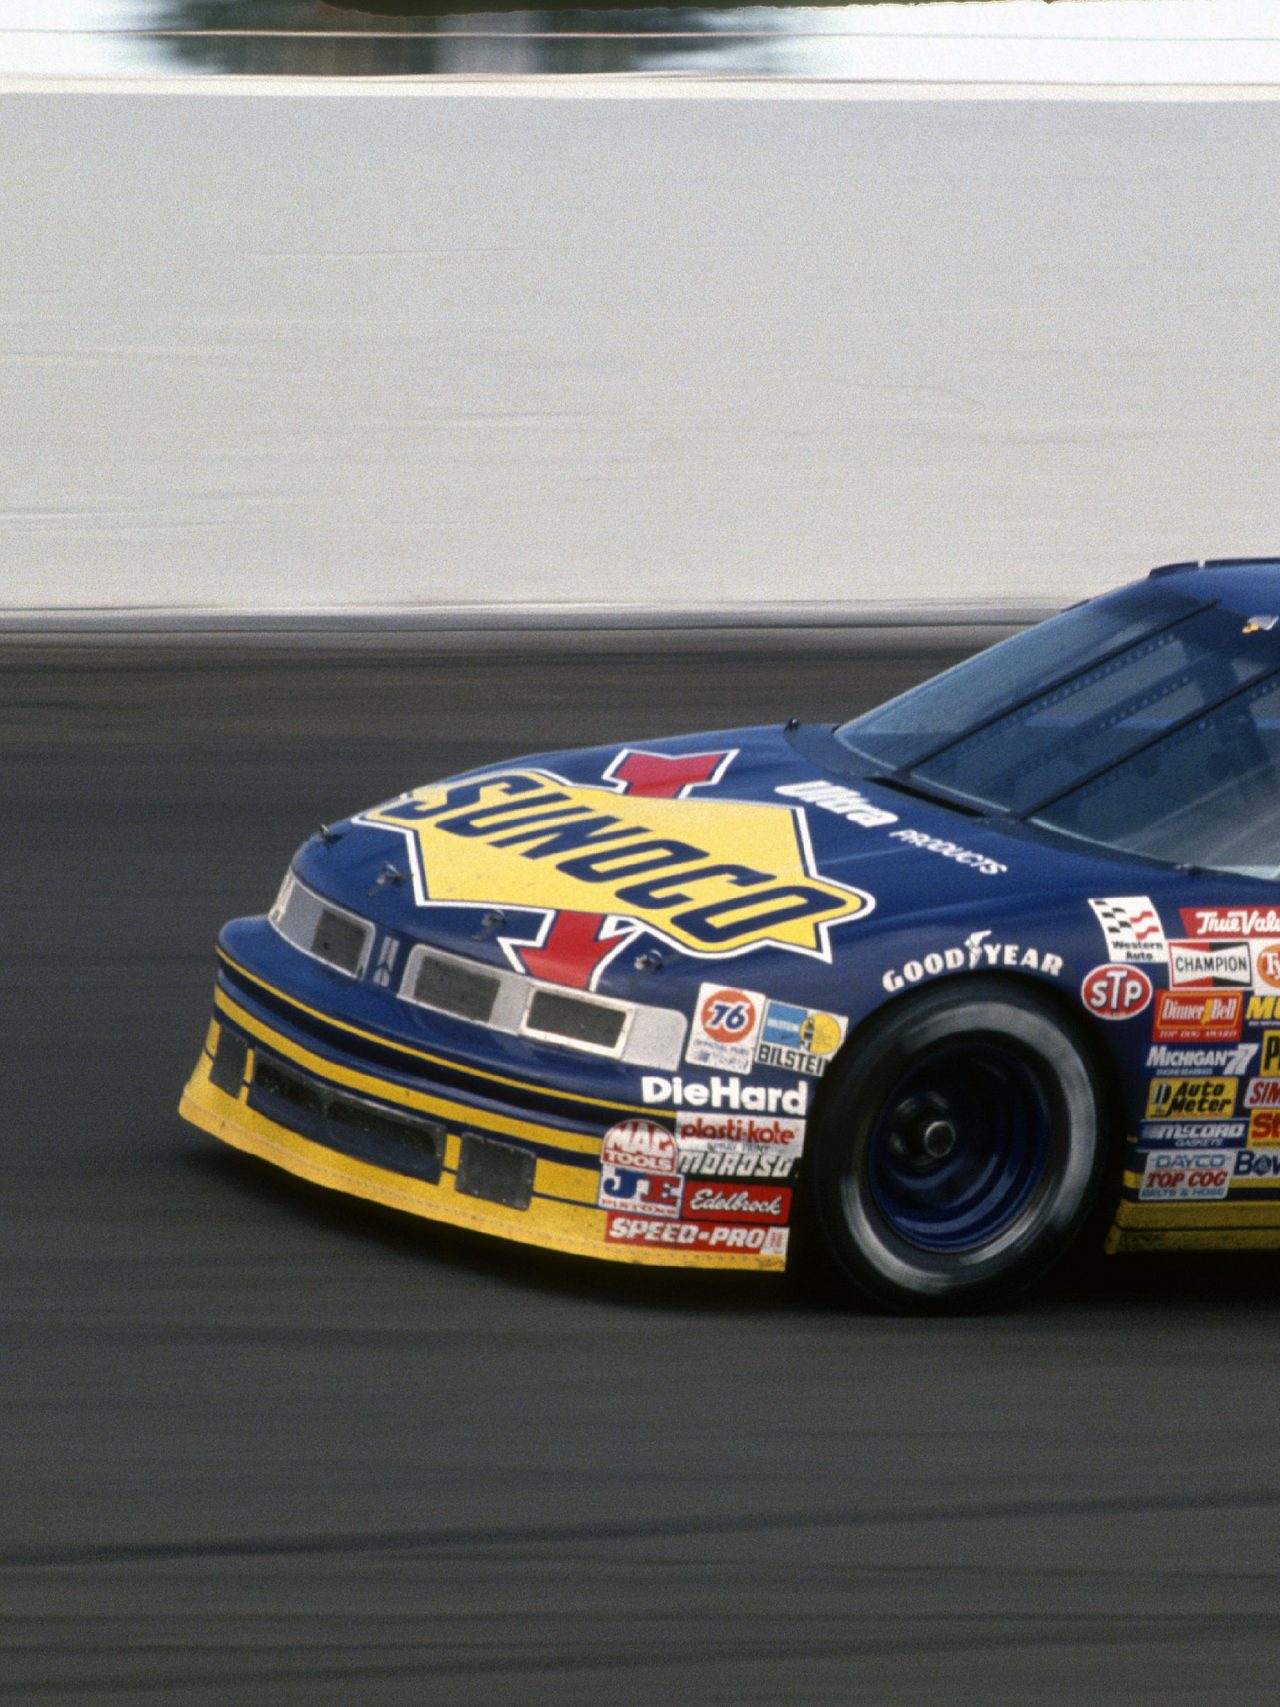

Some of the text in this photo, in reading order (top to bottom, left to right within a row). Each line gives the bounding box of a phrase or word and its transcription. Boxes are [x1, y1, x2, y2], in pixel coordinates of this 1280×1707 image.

[774, 780, 899, 828] Ultra
[379, 774, 848, 944] SUNOCO
[889, 829, 1008, 875] PRODUCTS
[1112, 941, 1163, 949] Western
[1126, 951, 1153, 960] Auto
[1175, 951, 1248, 972] CHAMPION
[1090, 970, 1143, 1010] STP
[706, 1001, 748, 1031] 76
[1161, 998, 1238, 1019] Dinner Bell
[758, 1043, 830, 1075] BILSTEI
[1145, 1043, 1260, 1076] MICHIGAN 77
[641, 1076, 809, 1116] DieHard
[1173, 1081, 1225, 1097] Auto
[1171, 1097, 1232, 1113] Meter
[680, 1117, 796, 1146] plasti-kote
[605, 1152, 672, 1172] TOOLS
[679, 1151, 795, 1177] MOROSO
[1155, 1154, 1226, 1168] DAYCO
[1146, 1170, 1228, 1188] TOP COG
[689, 1188, 783, 1216] Edelbrock
